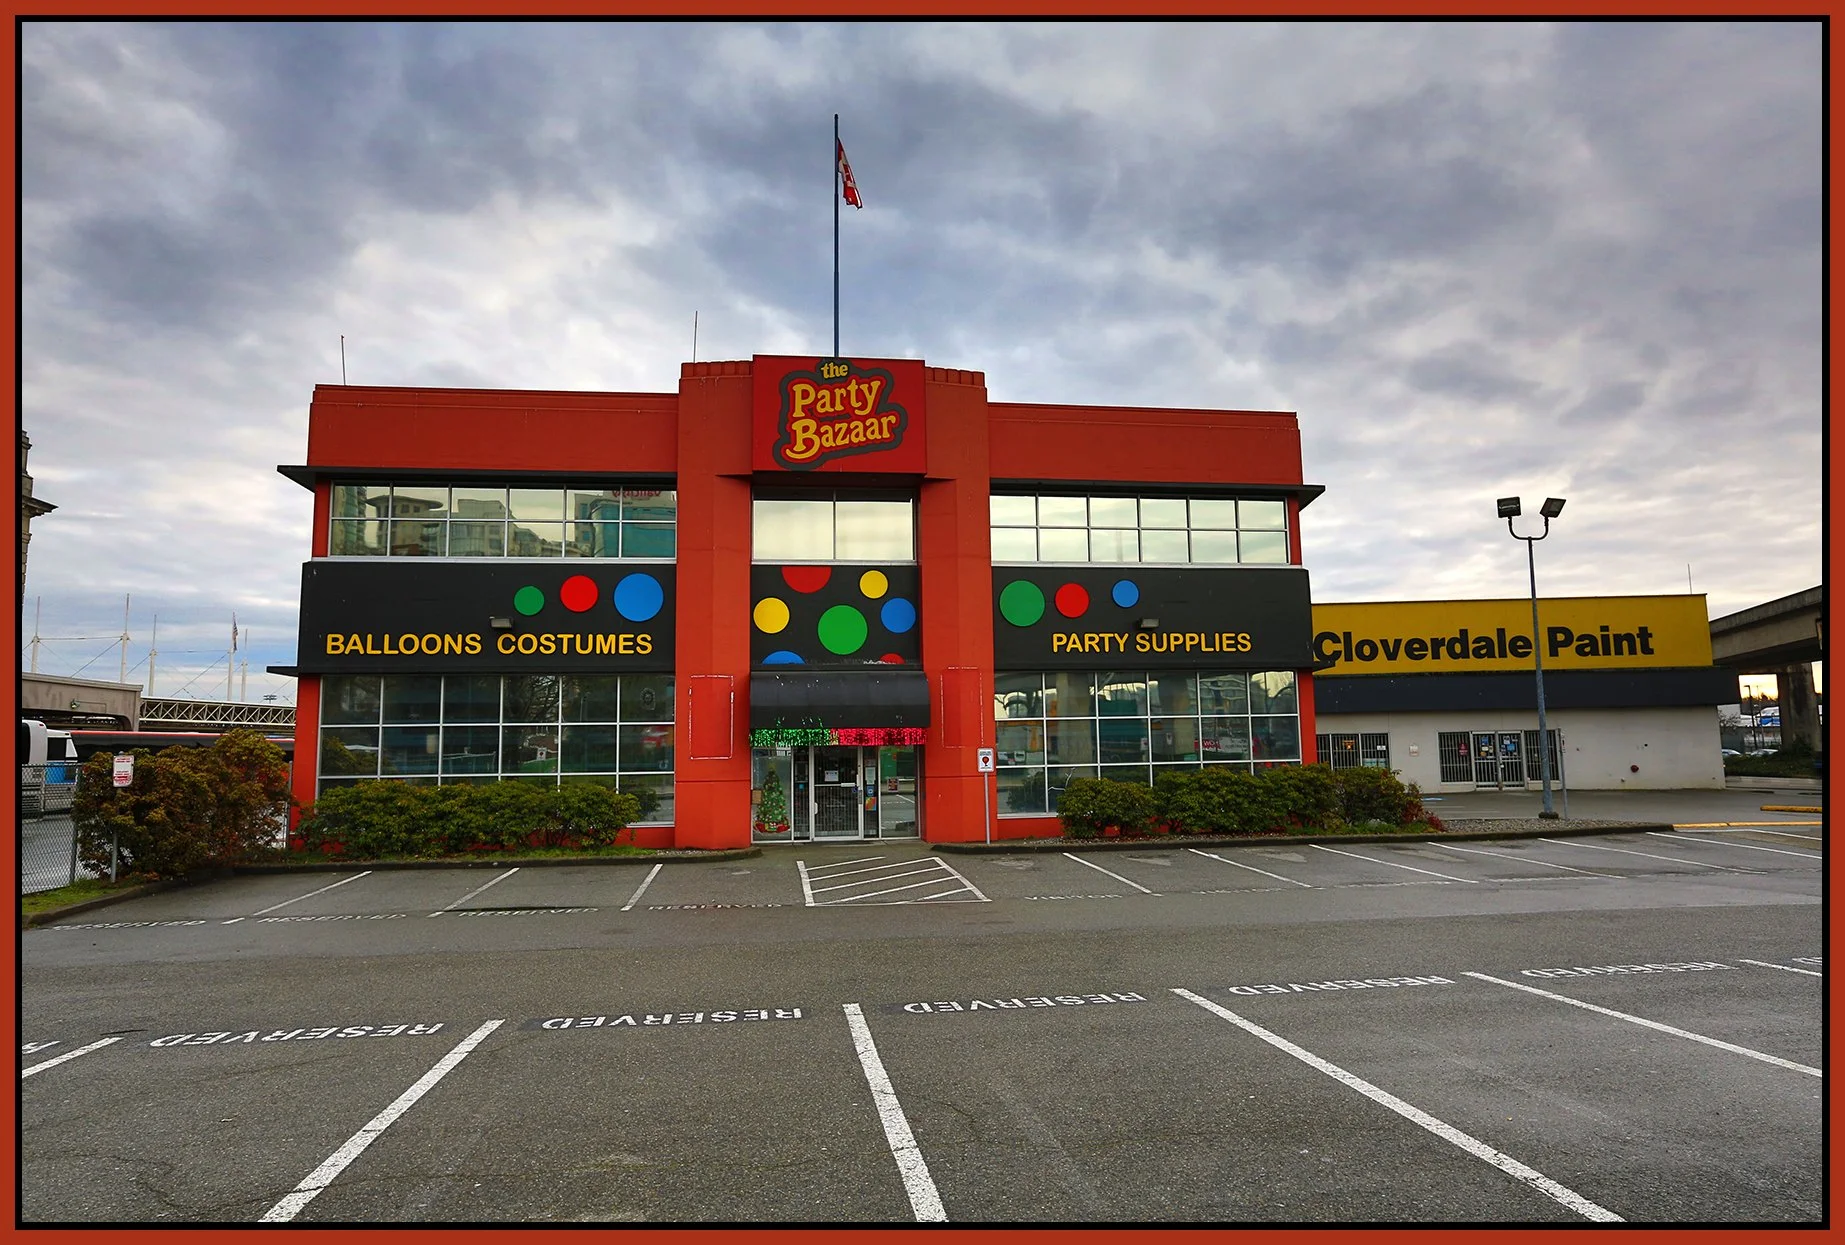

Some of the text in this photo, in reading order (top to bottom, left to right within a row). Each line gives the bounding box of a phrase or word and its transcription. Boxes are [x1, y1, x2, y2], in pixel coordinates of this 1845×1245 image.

[820, 362, 848, 379] the
[791, 379, 881, 418] Party
[785, 413, 896, 460] Bazaar
[325, 632, 653, 656] BALLOONS COSTUMES
[1051, 631, 1252, 654] PARTY SUPPLIES
[1314, 624, 1655, 664] Cloverdale Paint
[1228, 975, 1456, 996] RESERVED
[903, 991, 1148, 1014] RESERVED
[541, 1007, 803, 1030] RESERVED
[149, 1022, 444, 1048] RESERVED
